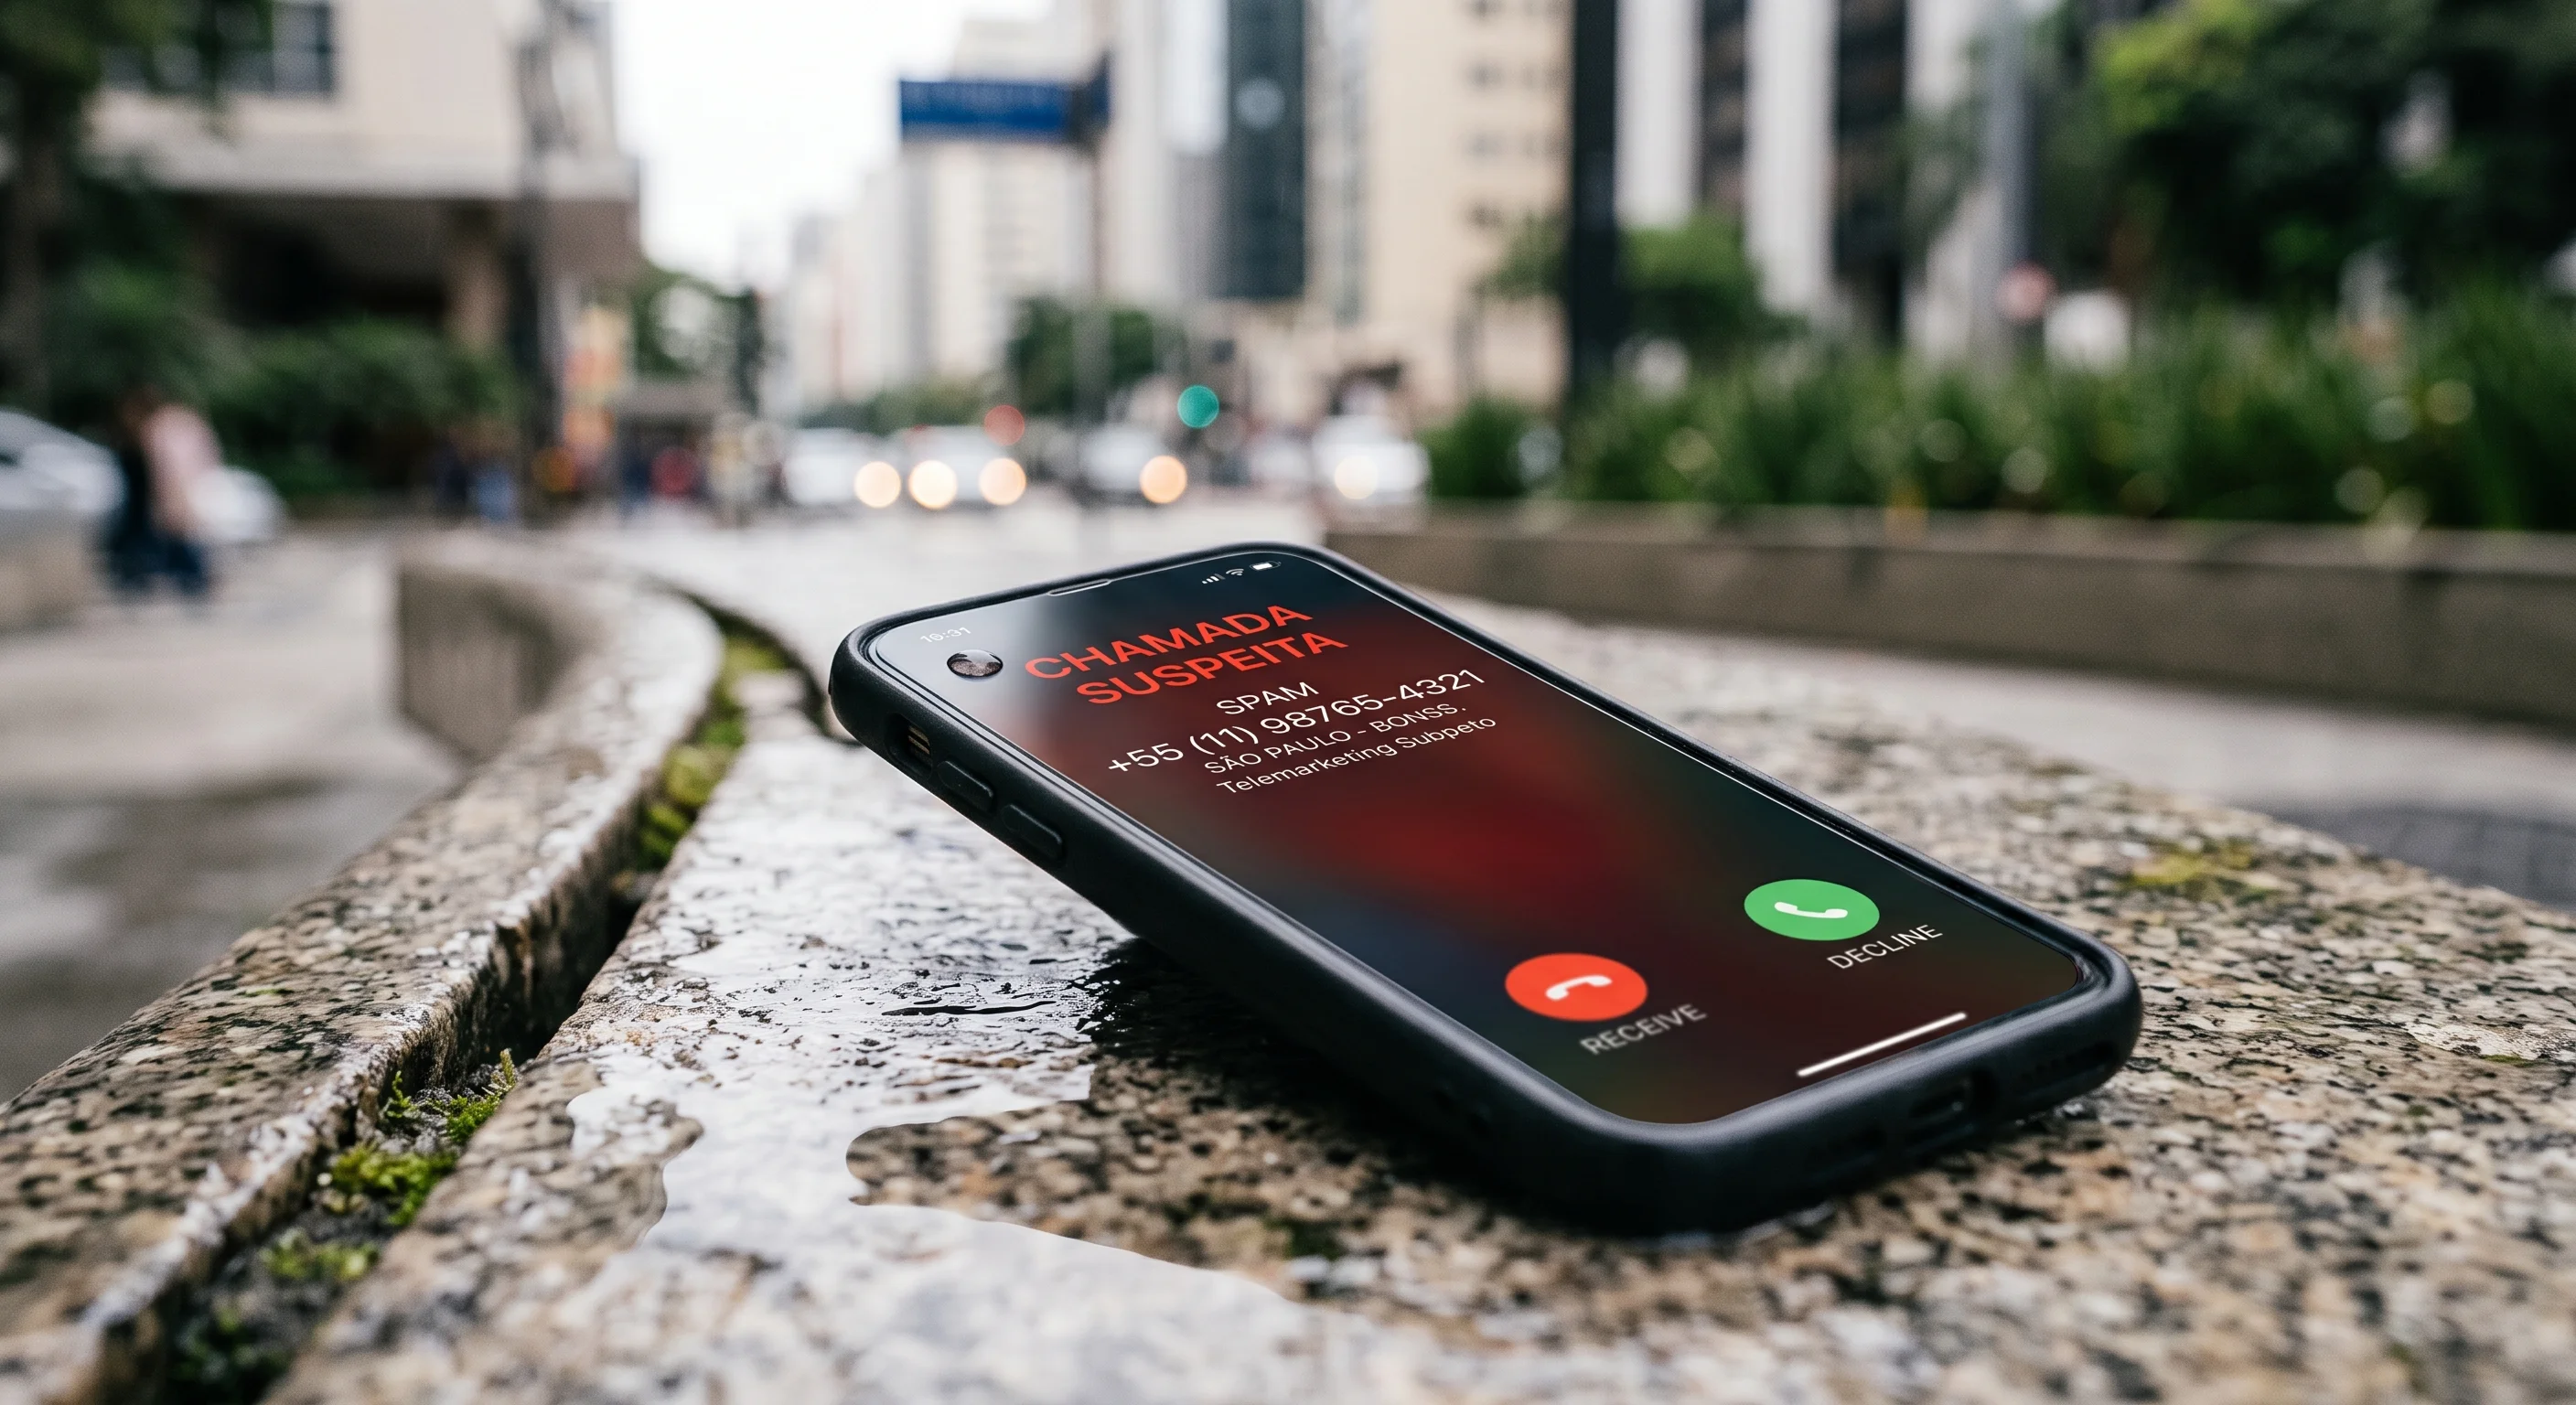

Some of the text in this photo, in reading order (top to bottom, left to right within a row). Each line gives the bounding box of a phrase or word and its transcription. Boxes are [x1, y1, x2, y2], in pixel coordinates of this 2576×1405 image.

[1025, 604, 1314, 680] CHAMADA
[1076, 631, 1349, 704] SUSPEITA
[1108, 669, 1486, 773] +55 (11) 98765-4321
[1216, 681, 1319, 715] SPAM
[1204, 752, 1262, 774] SÃO
[1264, 730, 1351, 759] PAULO
[1369, 702, 1466, 733] BONSS.
[1216, 717, 1497, 794] Telemarketing Subpeto
[1827, 924, 1944, 970] DECLINE
[1580, 1003, 1708, 1055] RECEIVE
